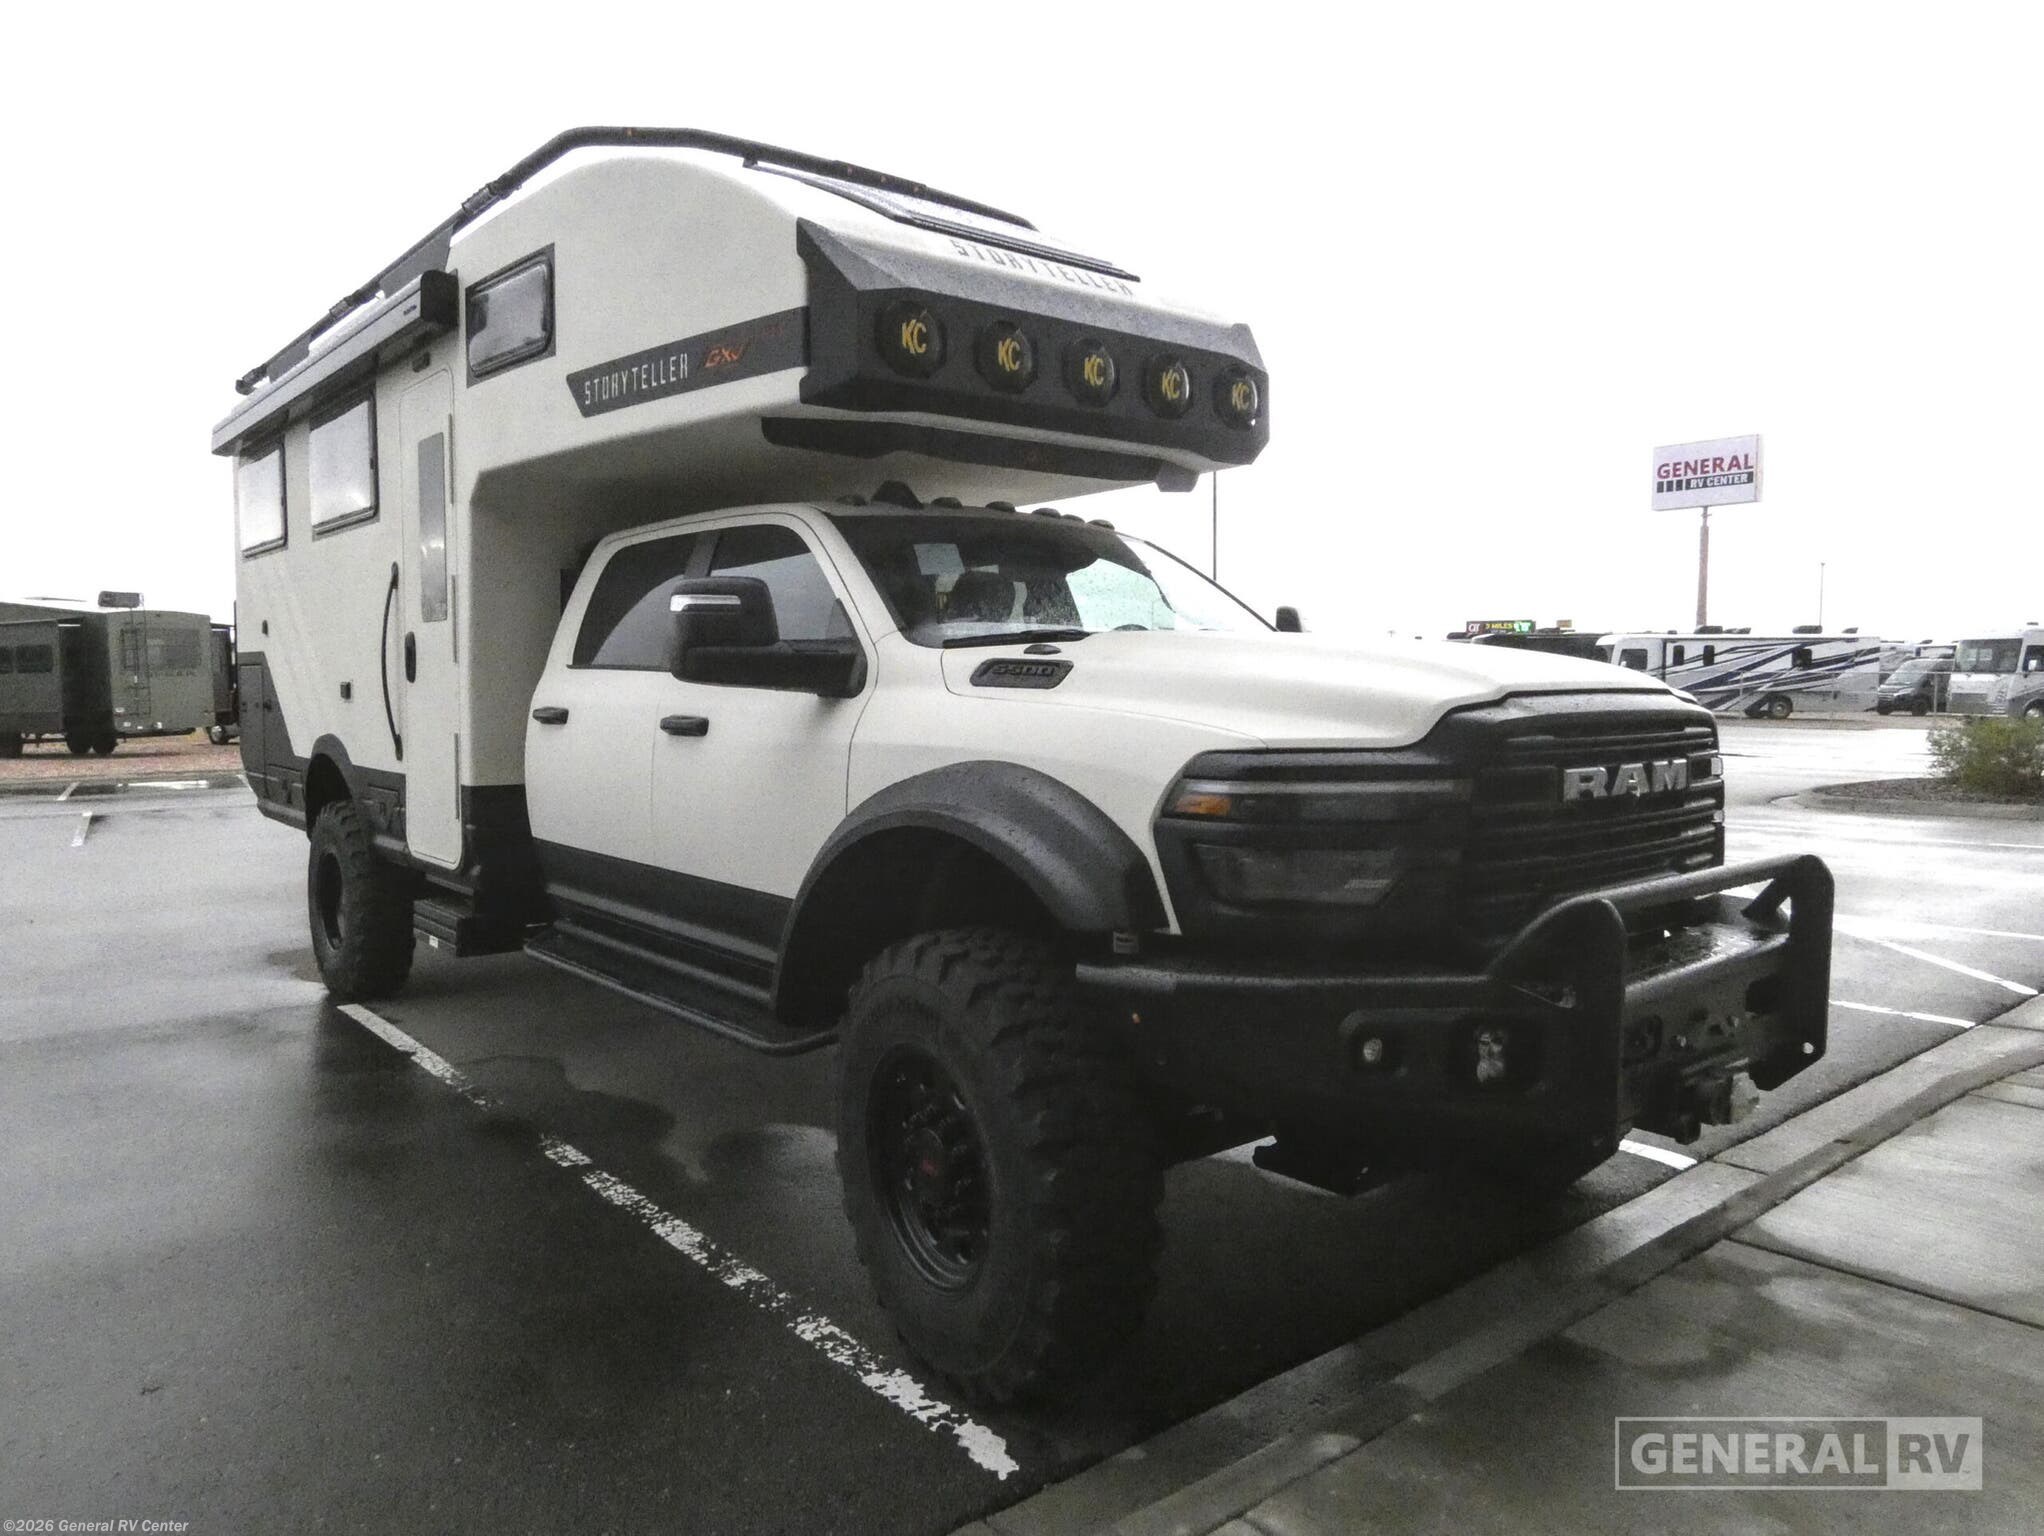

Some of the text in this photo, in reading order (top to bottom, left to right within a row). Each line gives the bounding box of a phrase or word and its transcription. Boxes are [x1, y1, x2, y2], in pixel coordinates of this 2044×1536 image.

[950, 239, 1134, 296] STORYTELLER
[902, 319, 927, 355] KC
[998, 337, 1020, 372] KC
[1084, 354, 1104, 387] KC
[584, 353, 688, 405] STORYTELLER
[1162, 368, 1181, 401] KC
[1232, 382, 1250, 411] KC
[1656, 453, 1754, 480] GENERAL
[1690, 473, 1749, 489] RV CENTER
[1563, 758, 1688, 800] RAM
